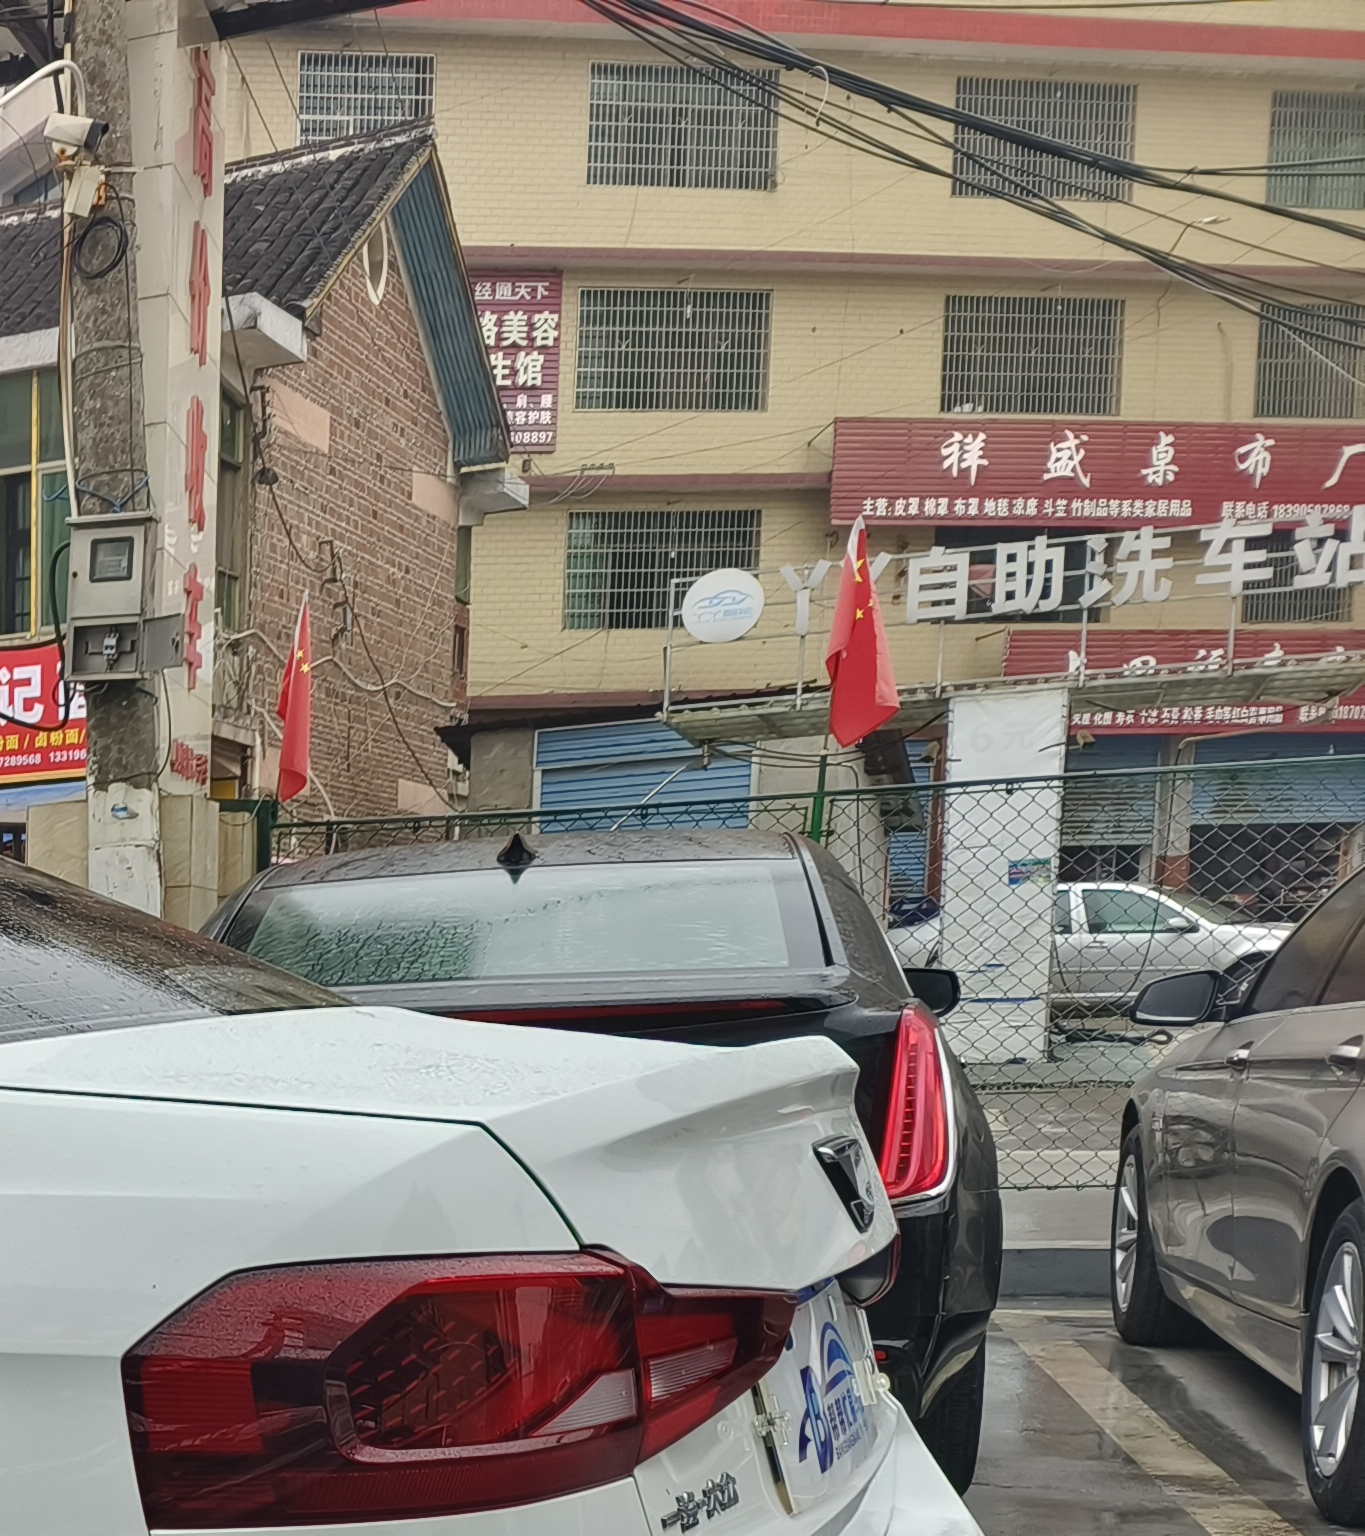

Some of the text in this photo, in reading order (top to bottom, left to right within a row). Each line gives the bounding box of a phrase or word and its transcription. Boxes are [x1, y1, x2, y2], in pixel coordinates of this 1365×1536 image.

[940, 429, 1365, 488] 祥盛桌布厂
[1221, 500, 1270, 520] 联系电话
